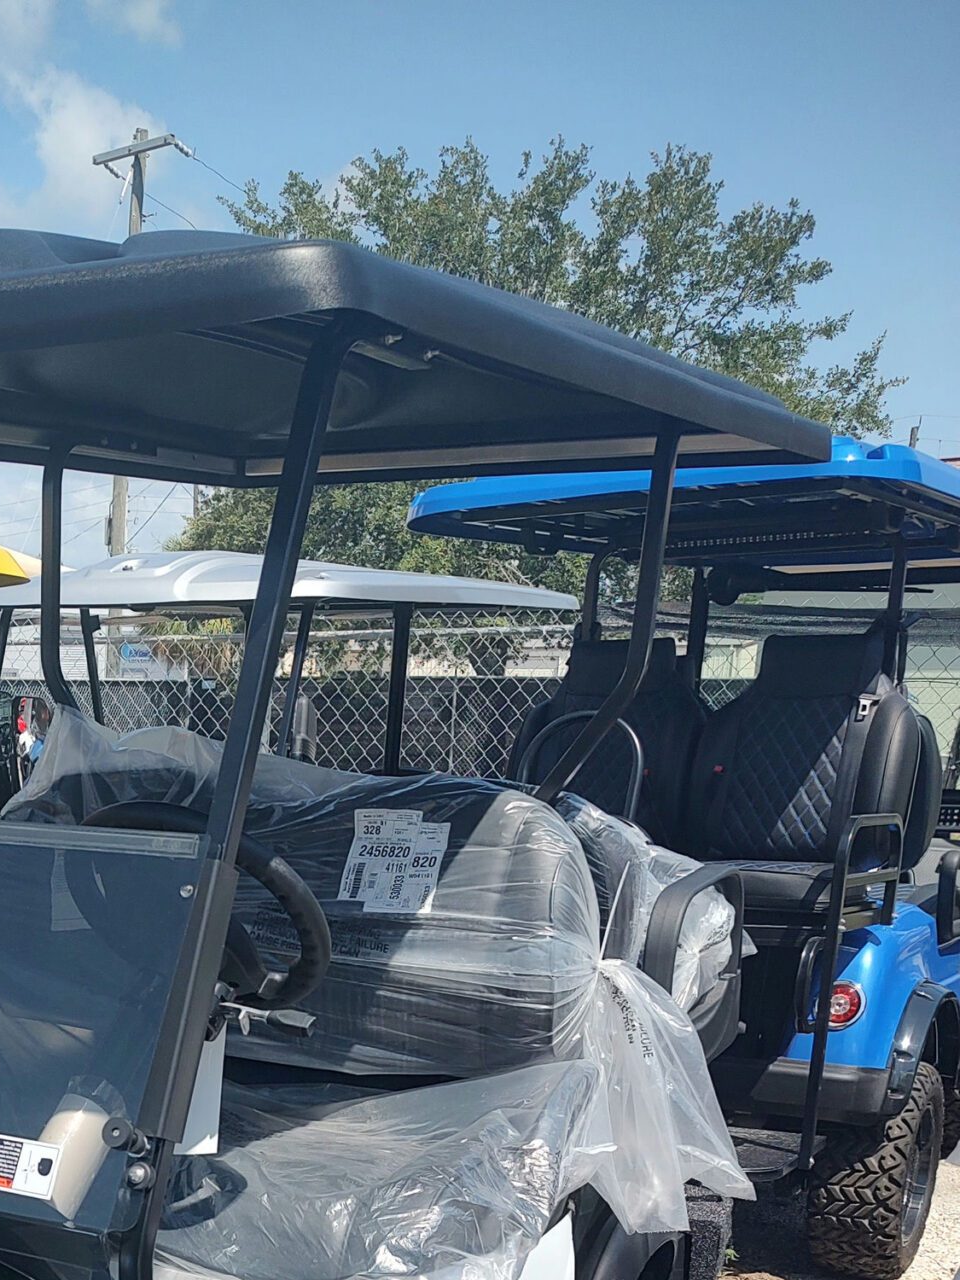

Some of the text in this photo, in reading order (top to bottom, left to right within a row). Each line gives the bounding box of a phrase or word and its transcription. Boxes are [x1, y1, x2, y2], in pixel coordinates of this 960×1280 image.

[363, 825, 382, 836] 328
[359, 845, 411, 858] 2456820
[385, 862, 408, 874] 41161
[411, 856, 437, 868] 820
